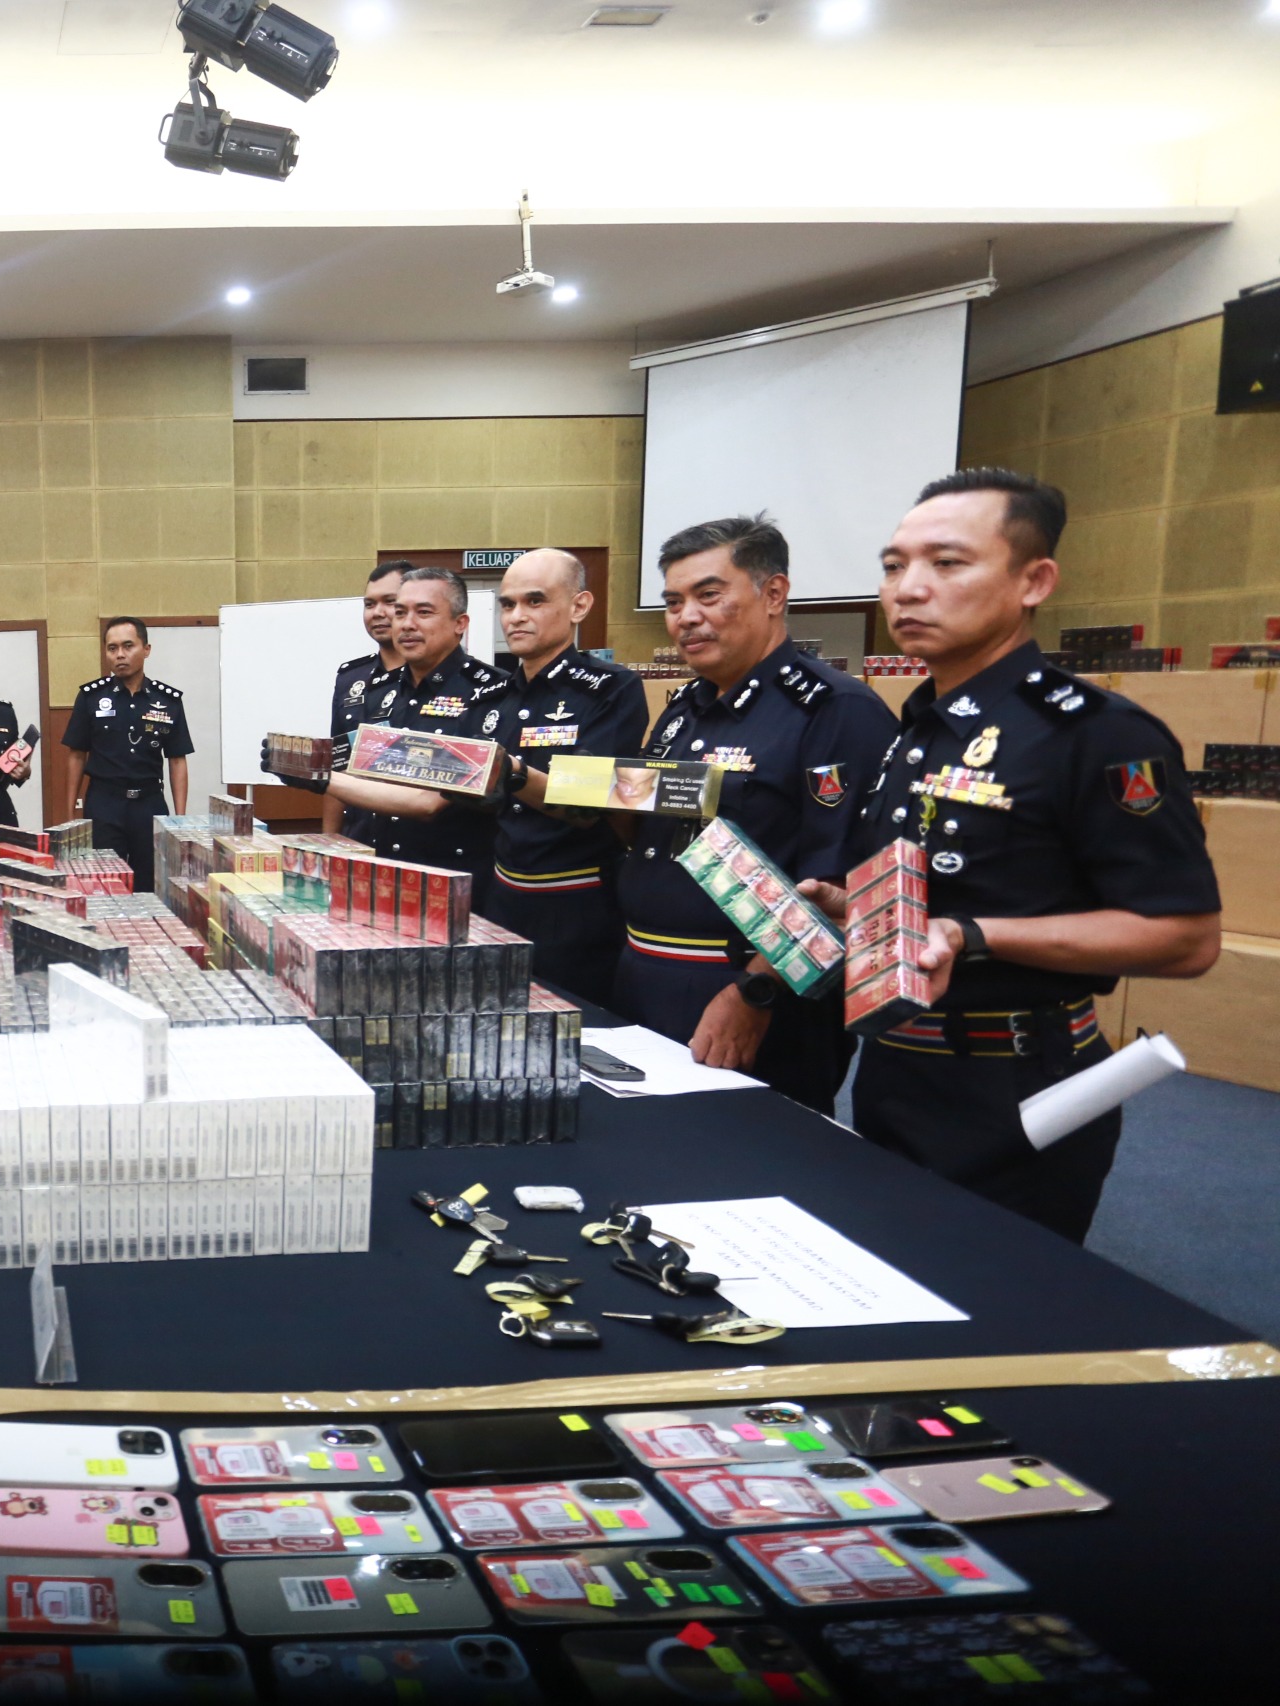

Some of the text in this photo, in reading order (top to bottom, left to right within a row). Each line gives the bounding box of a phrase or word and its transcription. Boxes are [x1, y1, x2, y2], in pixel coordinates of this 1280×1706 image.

[468, 553, 512, 567] KELUAR
[376, 762, 457, 784] GAJAH BARU
[646, 761, 678, 769] WARNING
[662, 776, 684, 784] Smoking
[770, 1272, 825, 1311] MOHAMAD
[828, 1281, 872, 1310] KASTAM
